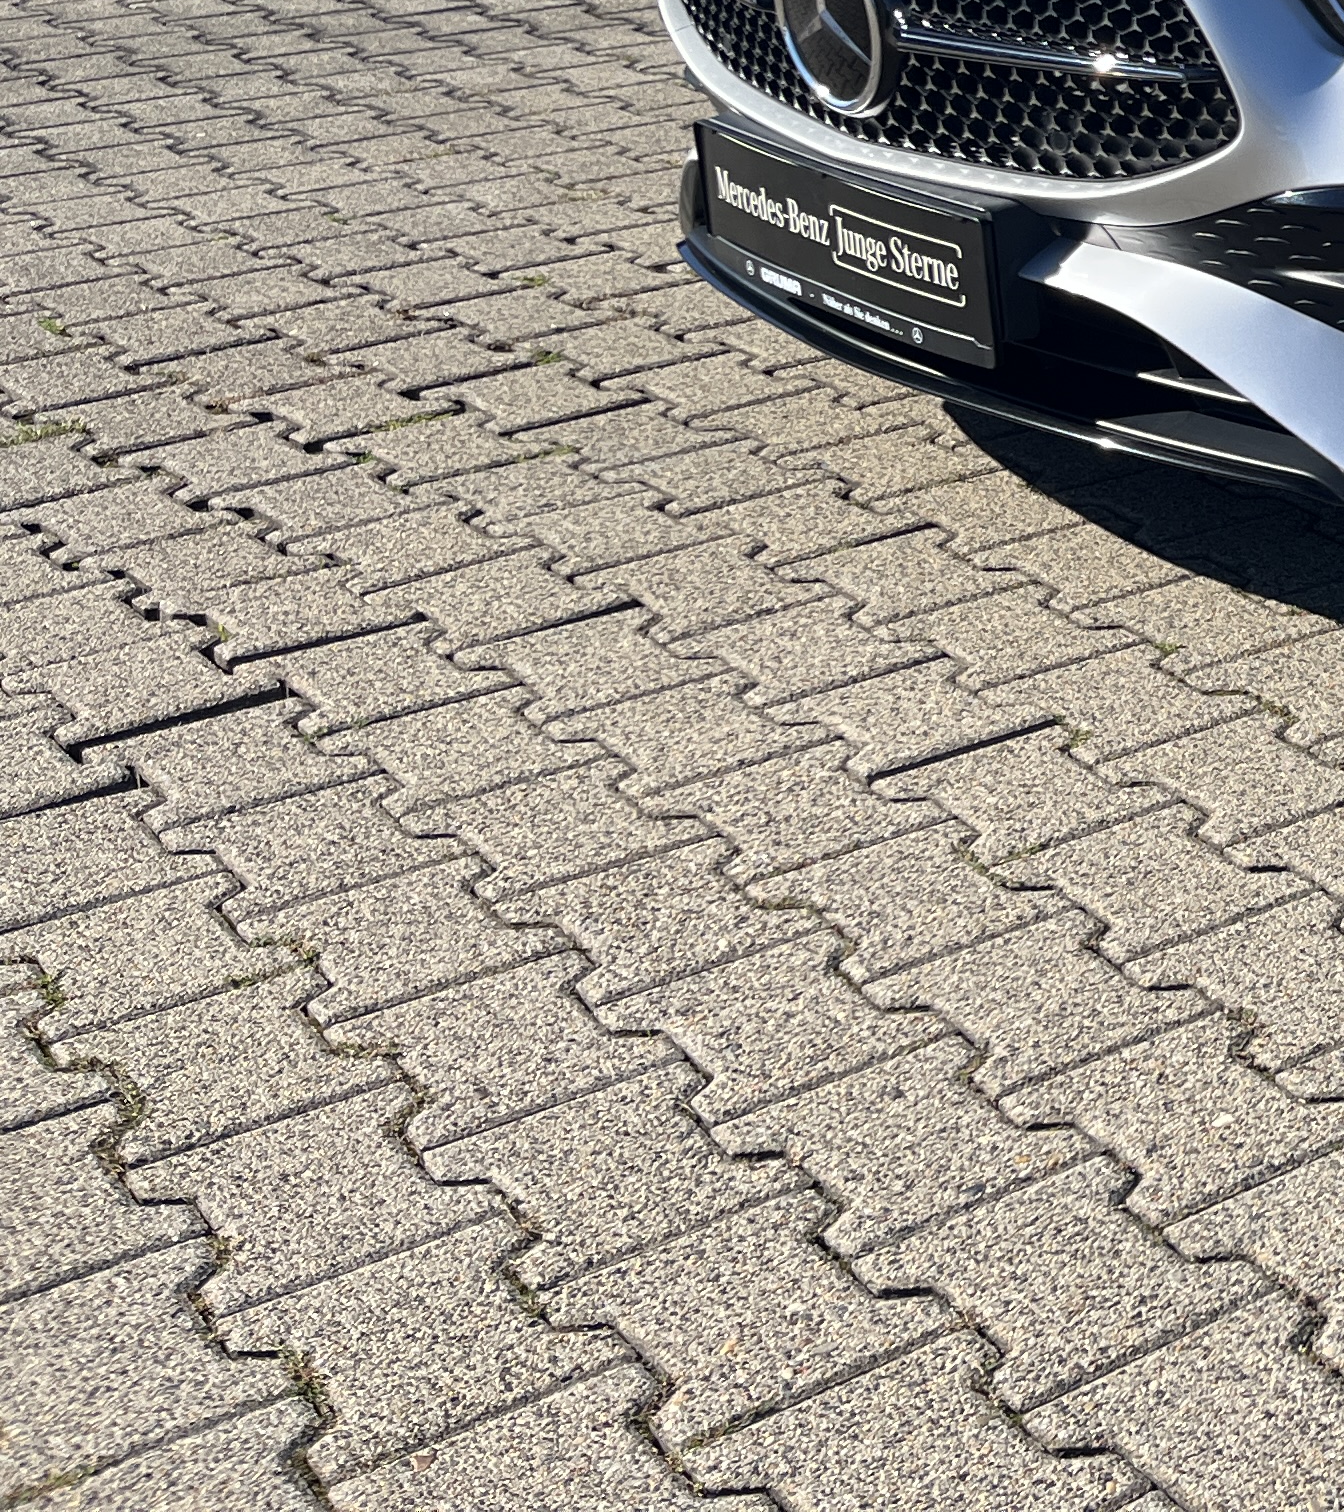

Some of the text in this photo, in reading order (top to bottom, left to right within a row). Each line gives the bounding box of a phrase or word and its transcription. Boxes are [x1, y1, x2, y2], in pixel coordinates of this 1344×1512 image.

[714, 166, 961, 291] Mercedes-Benz Junge Sterne
